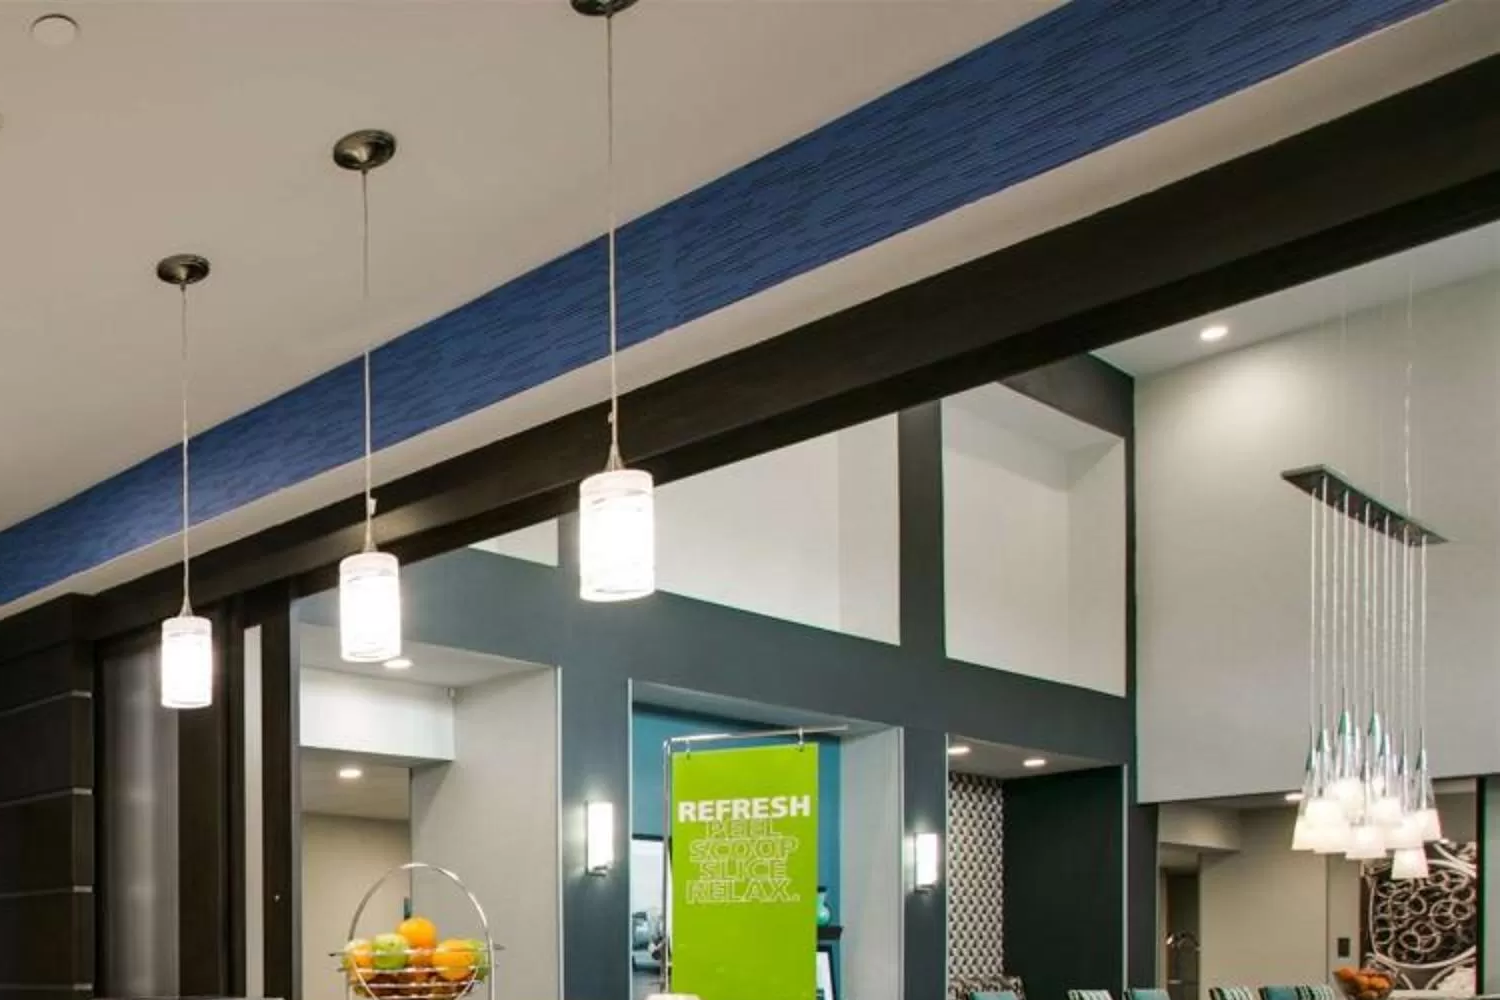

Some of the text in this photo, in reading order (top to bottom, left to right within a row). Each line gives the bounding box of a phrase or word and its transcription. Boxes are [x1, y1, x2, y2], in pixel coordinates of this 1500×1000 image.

[677, 795, 811, 823] REFRESH
[689, 836, 799, 863] SCOOP
[699, 858, 788, 882] SLICE
[686, 878, 801, 904] RELAX.
